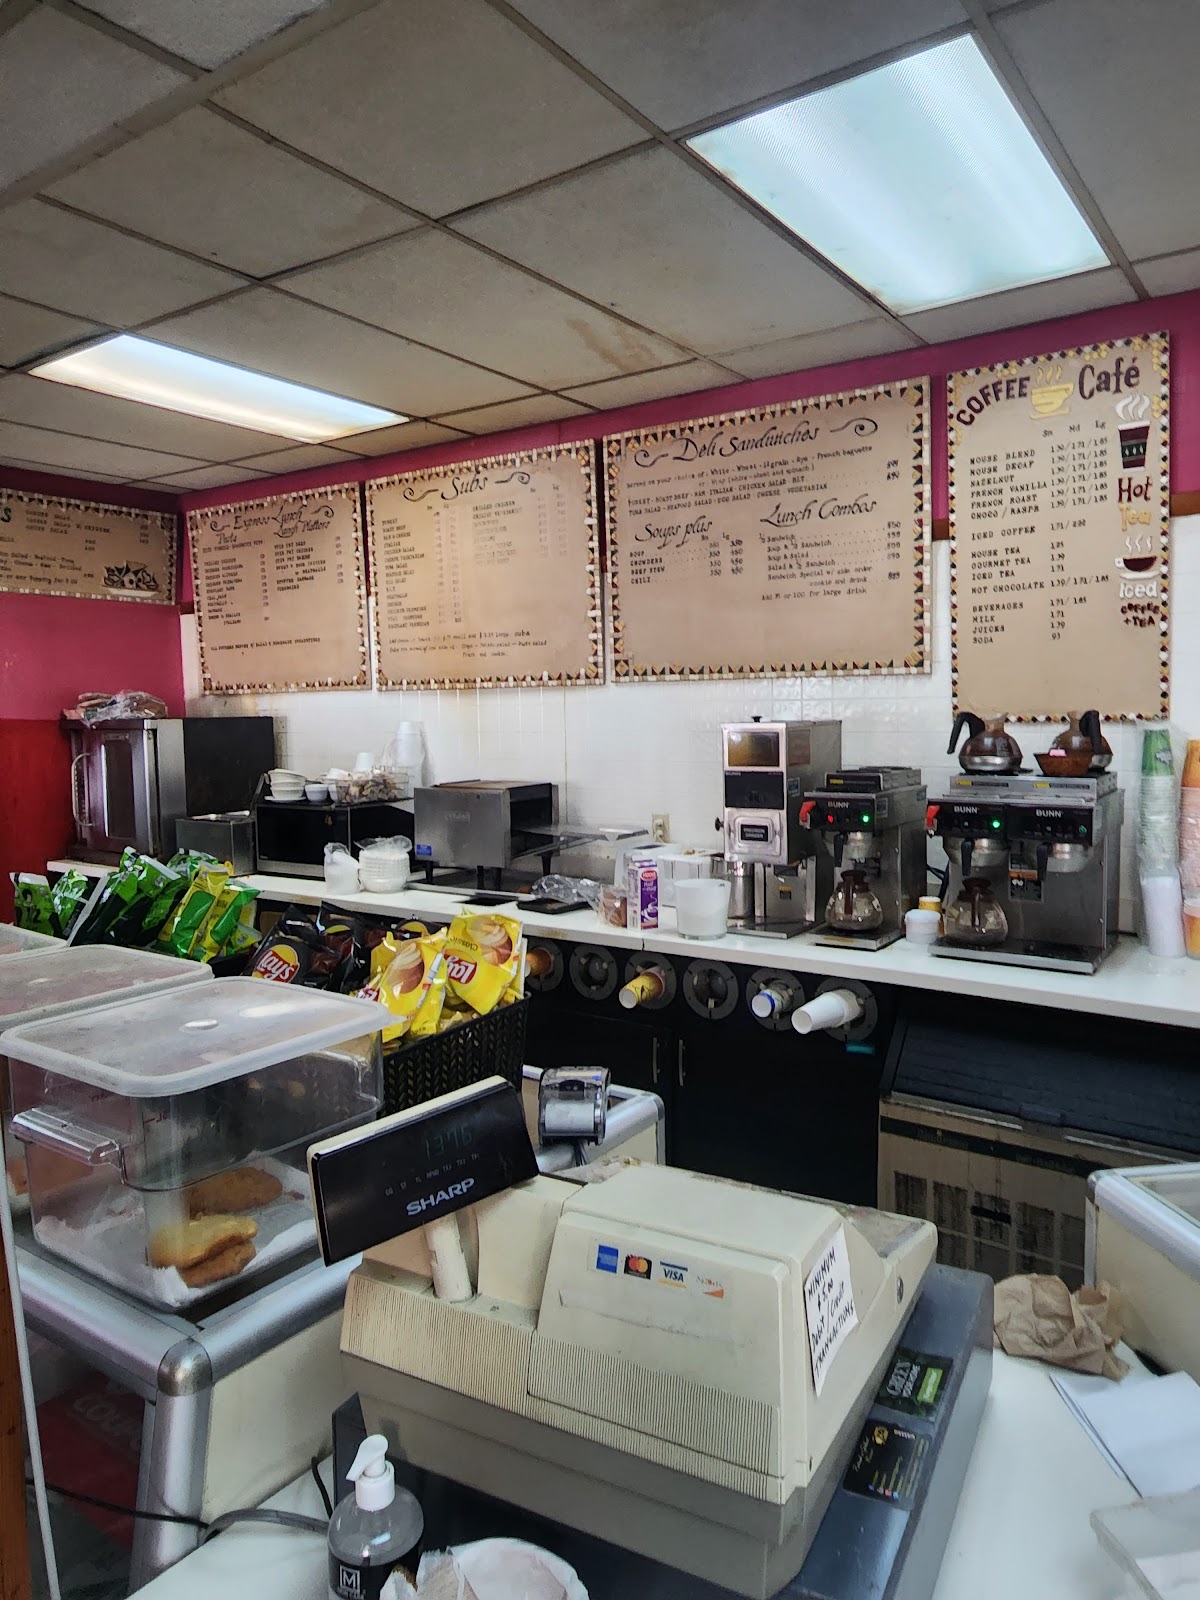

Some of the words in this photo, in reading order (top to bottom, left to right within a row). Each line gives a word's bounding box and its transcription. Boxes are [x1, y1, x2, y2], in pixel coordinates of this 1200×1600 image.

[956, 376, 1030, 426] COFFEE
[1078, 356, 1141, 403] Café
[1006, 449, 1036, 460] BLEND
[440, 469, 488, 501] Subs
[1118, 476, 1153, 503] Hot
[971, 530, 994, 542] ICED
[1000, 526, 1036, 538] COFFEE
[971, 548, 998, 560] HOUSE
[971, 572, 993, 582] ICED
[972, 586, 988, 597] HOT
[993, 581, 1045, 594] CHOCOLATE
[1119, 581, 1158, 600] Iced
[972, 601, 1024, 614] BEVERAGES
[1120, 602, 1160, 615] COFFEE
[972, 616, 996, 624] MILK
[972, 624, 1005, 636] JUICES
[972, 637, 994, 646] SODA
[827, 801, 849, 809] BUNN
[954, 805, 979, 814] BUNN
[1036, 809, 1063, 818] BUNN
[449, 936, 478, 952] Classic
[256, 950, 295, 980] Lay's
[406, 1177, 475, 1216] SHARP
[663, 1268, 685, 1283] VISA
[808, 1246, 836, 1301] MINIMUM
